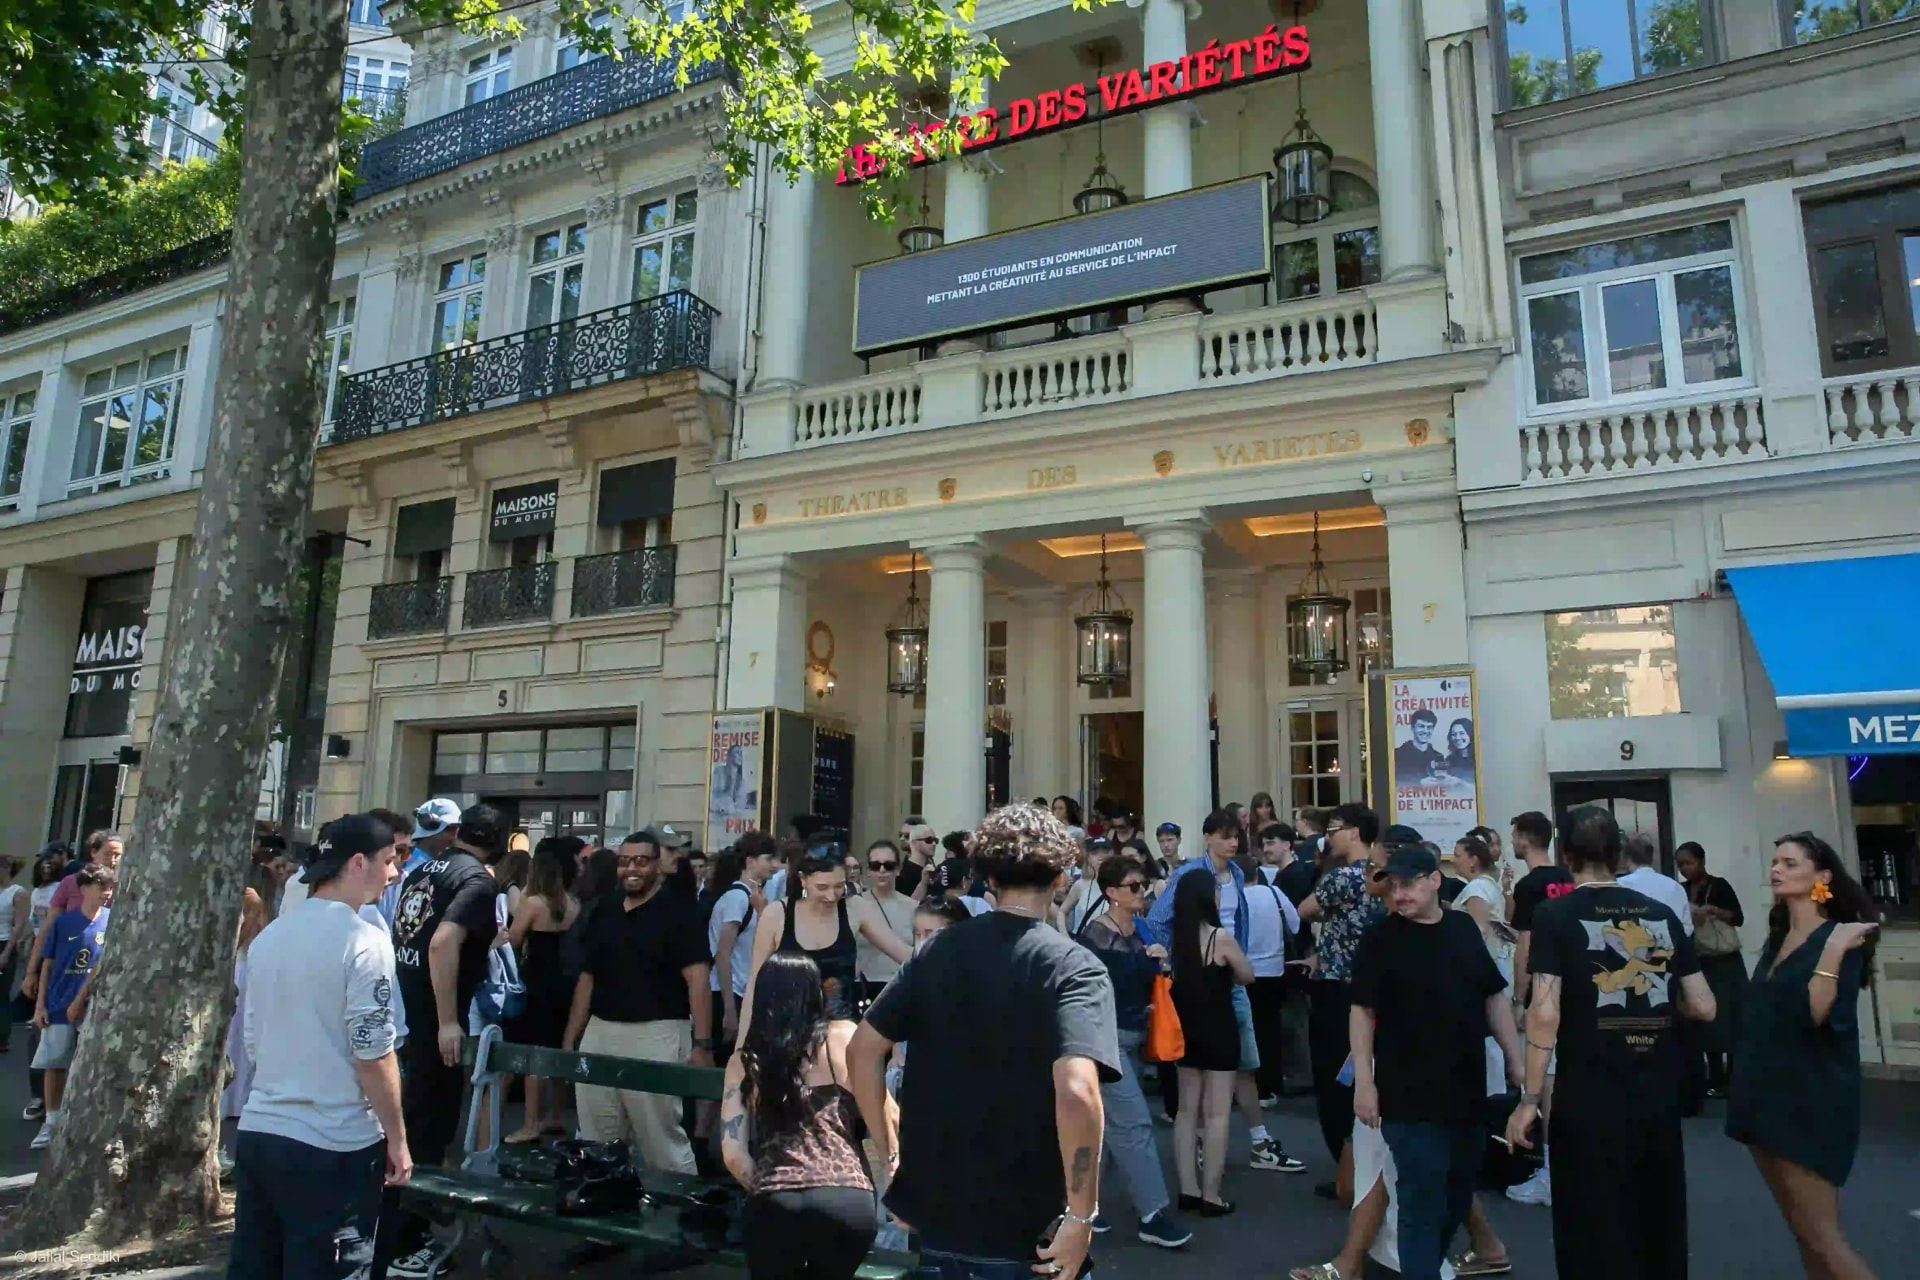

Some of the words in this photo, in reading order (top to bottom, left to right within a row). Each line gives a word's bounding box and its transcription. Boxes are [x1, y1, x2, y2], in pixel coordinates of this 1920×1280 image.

[1008, 82, 1086, 137] DES
[1097, 23, 1310, 111] VARIÉTÉS
[958, 272, 980, 284] 1300
[981, 259, 1038, 279] ÉTUDIANTS
[1040, 256, 1054, 267] EN
[1055, 237, 1143, 264] COMMUNICATION
[927, 287, 973, 304] METTANT
[974, 283, 988, 295] LA
[989, 270, 1047, 291] CRÉATIVITÉ
[1048, 268, 1063, 280] AU
[1065, 259, 1109, 276] SERVICE
[1111, 255, 1125, 266] DE
[1127, 244, 1178, 263] L'IMPACT
[798, 487, 908, 518] THEATRE
[1027, 464, 1076, 490] DES
[496, 492, 556, 516] MAISONS
[494, 517, 507, 527] DU
[515, 510, 555, 524] MONDE
[75, 624, 147, 663] MAIS
[69, 675, 97, 694] DU
[1394, 684, 1410, 697] LA
[498, 689, 508, 708] 5
[1394, 692, 1470, 712] CRÉATIVITÉ
[1395, 713, 1412, 726] AU
[714, 731, 759, 748] REMISE
[1620, 740, 1634, 761] 9
[1398, 785, 1447, 798] SERVICE
[1398, 800, 1414, 811] DE
[1420, 798, 1474, 811] L'IMPACT
[725, 816, 755, 834] PRIX
